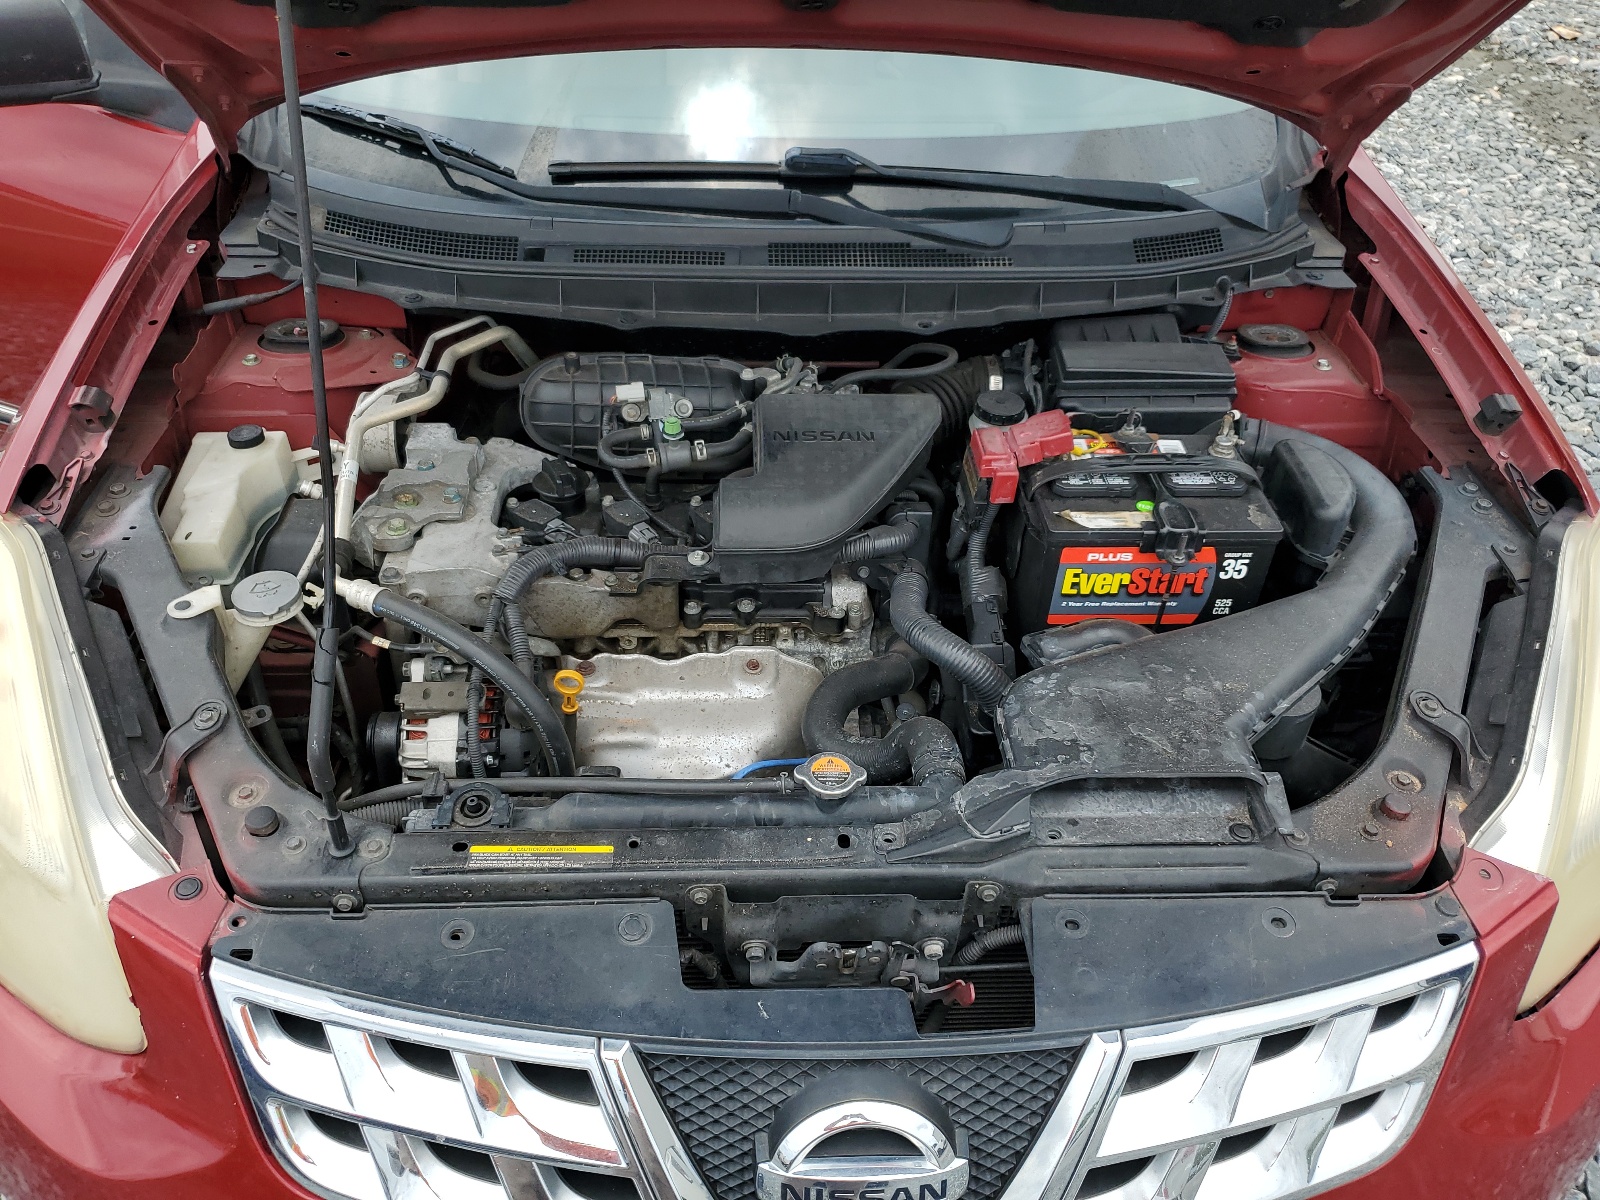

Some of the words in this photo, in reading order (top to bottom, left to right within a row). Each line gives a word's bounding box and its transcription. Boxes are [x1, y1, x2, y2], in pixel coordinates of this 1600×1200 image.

[773, 430, 875, 442] NISSAN
[1087, 552, 1134, 562] PLUS
[1219, 559, 1250, 580] 35
[1061, 567, 1209, 596] EverStart
[1214, 599, 1233, 607] 525
[1212, 607, 1230, 615] CCA
[781, 1179, 947, 1200] NISSAN
